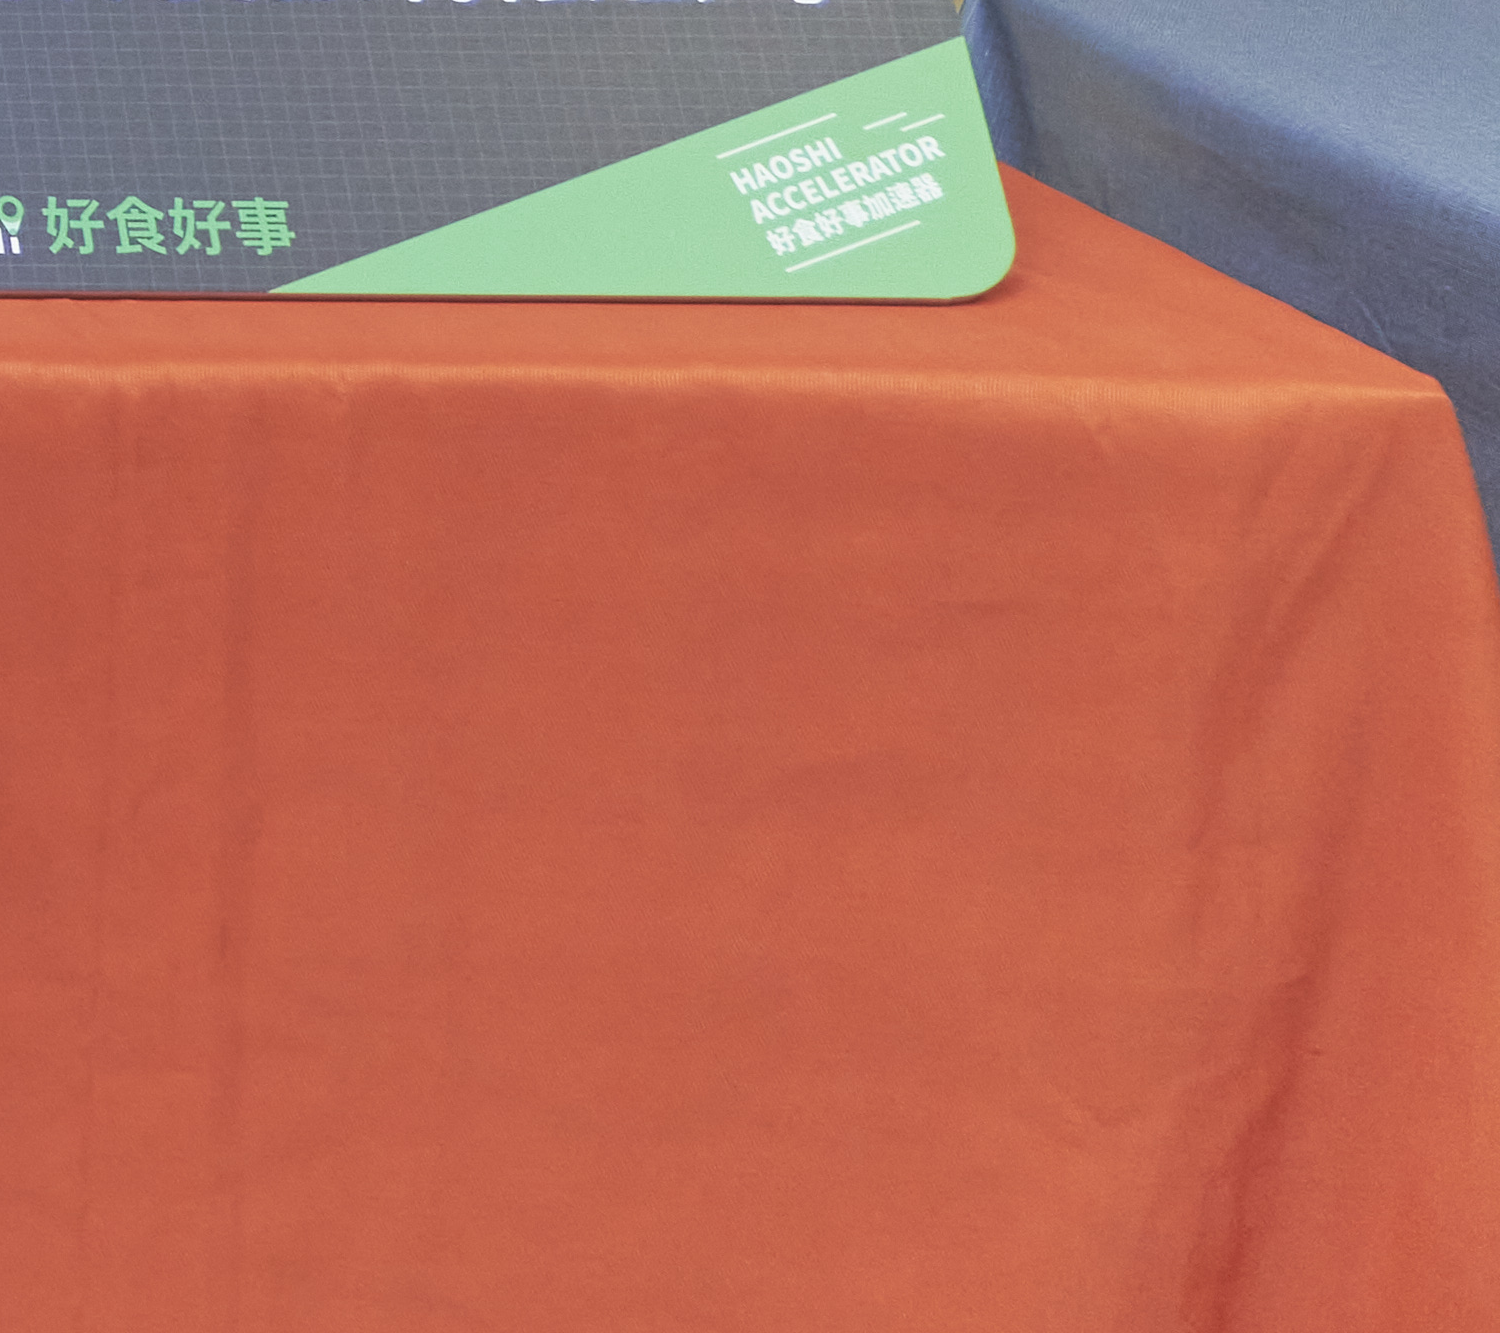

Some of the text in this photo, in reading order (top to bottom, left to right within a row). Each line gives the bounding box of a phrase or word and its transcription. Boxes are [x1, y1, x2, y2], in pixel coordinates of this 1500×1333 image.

[730, 137, 843, 195] HAOSHI
[750, 136, 946, 225] ACCELERATOR
[43, 194, 297, 258] 好食好事
[766, 173, 944, 257] 好食好事加速器
